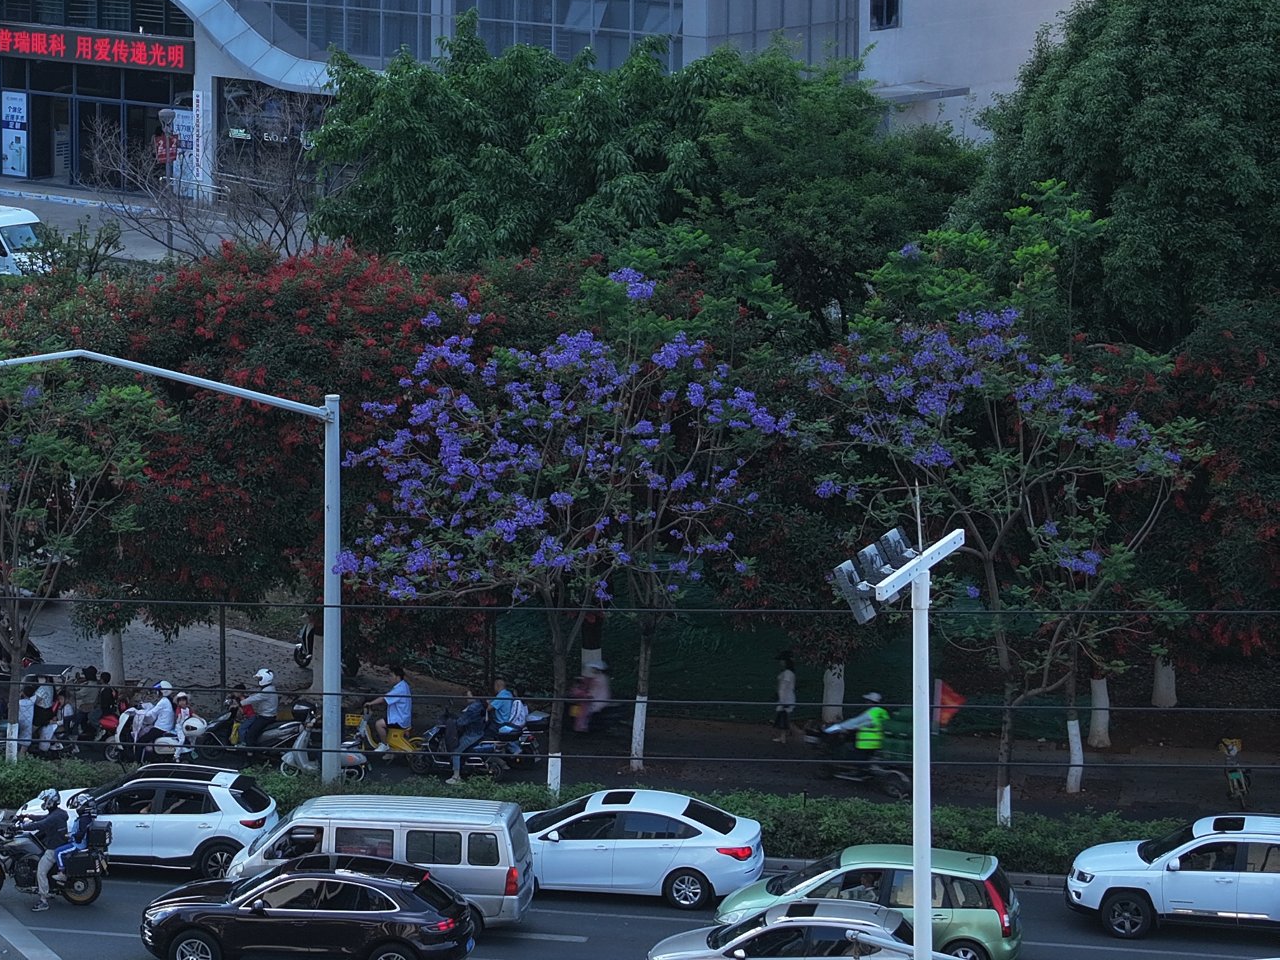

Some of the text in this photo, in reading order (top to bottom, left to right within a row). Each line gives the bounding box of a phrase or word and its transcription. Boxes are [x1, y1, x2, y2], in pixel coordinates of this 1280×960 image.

[75, 35, 185, 69] 用爱传递光明
